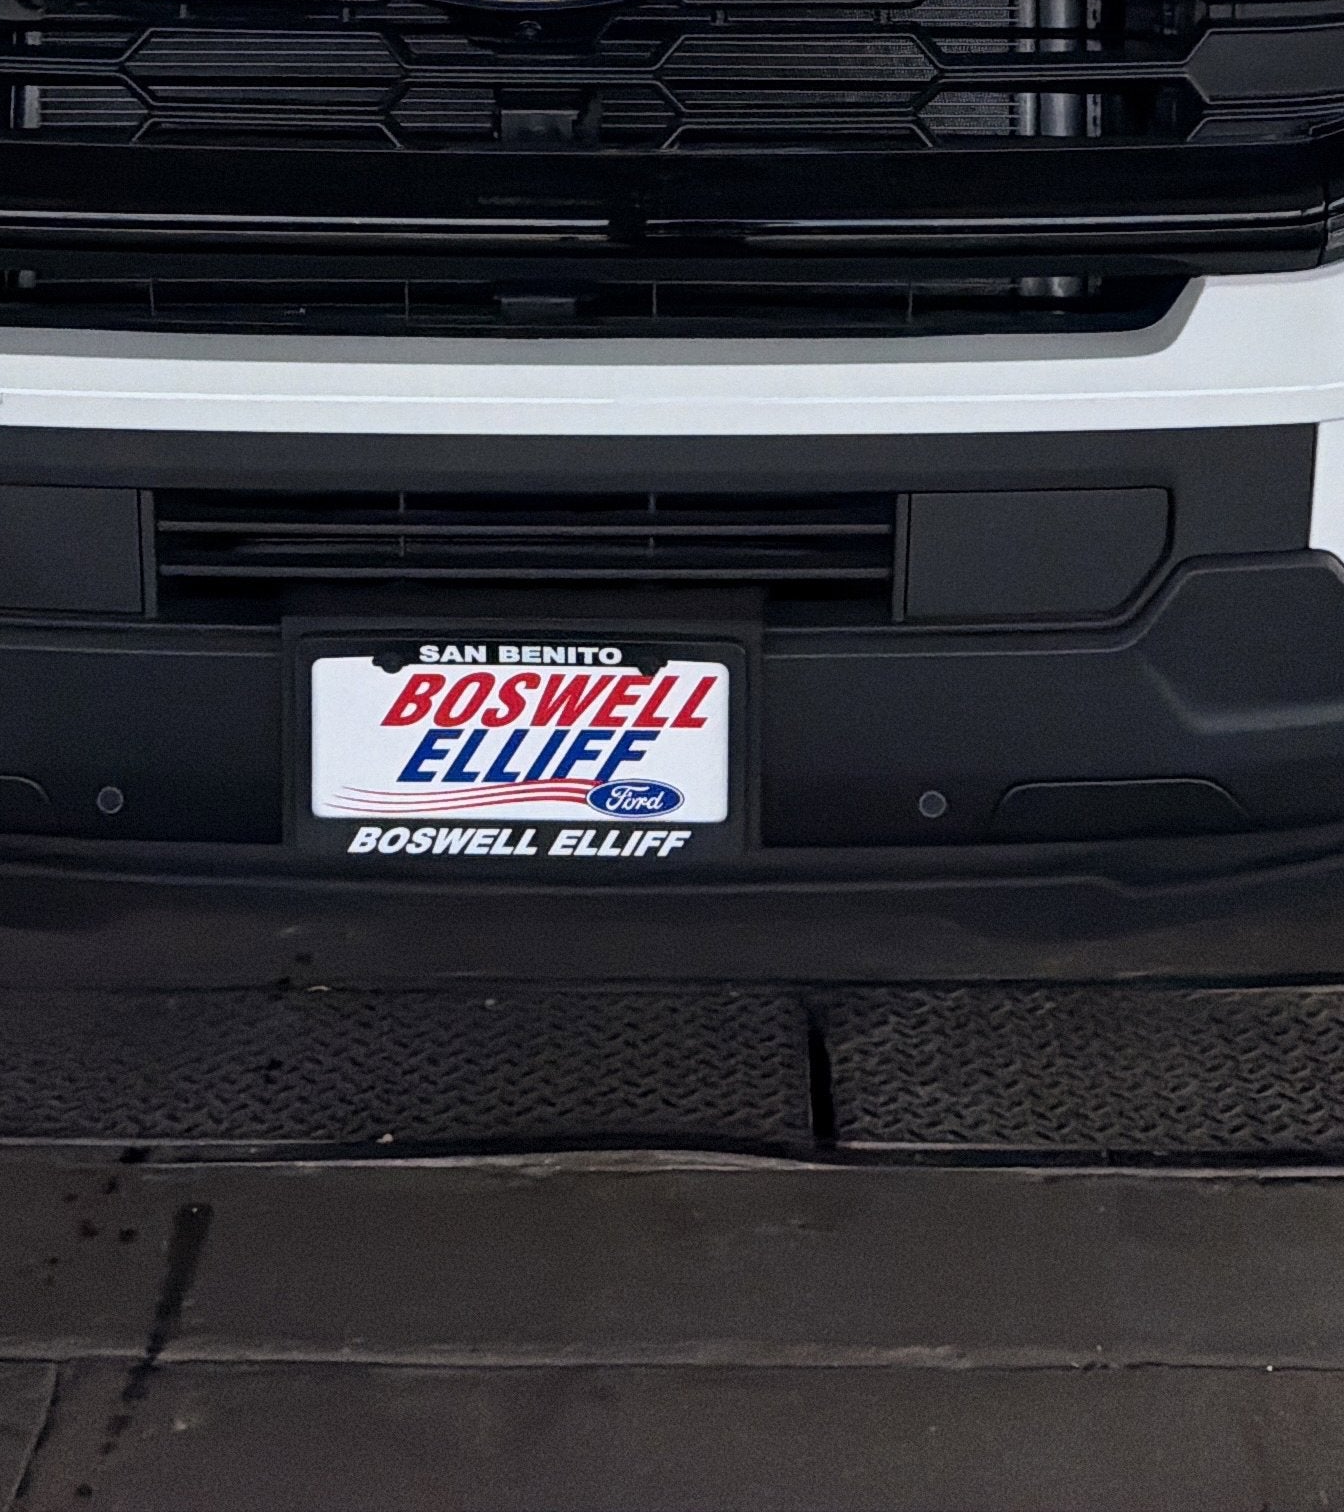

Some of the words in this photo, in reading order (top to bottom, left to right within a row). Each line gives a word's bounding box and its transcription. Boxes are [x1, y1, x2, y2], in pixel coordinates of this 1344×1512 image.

[419, 645, 487, 665] SAN
[498, 645, 623, 666] BENITO
[380, 672, 719, 729] BOSWELL
[396, 729, 661, 783] ELLIFF
[605, 786, 665, 812] Ford
[347, 826, 539, 856] BOSWELL
[547, 830, 692, 858] ELLIFF
